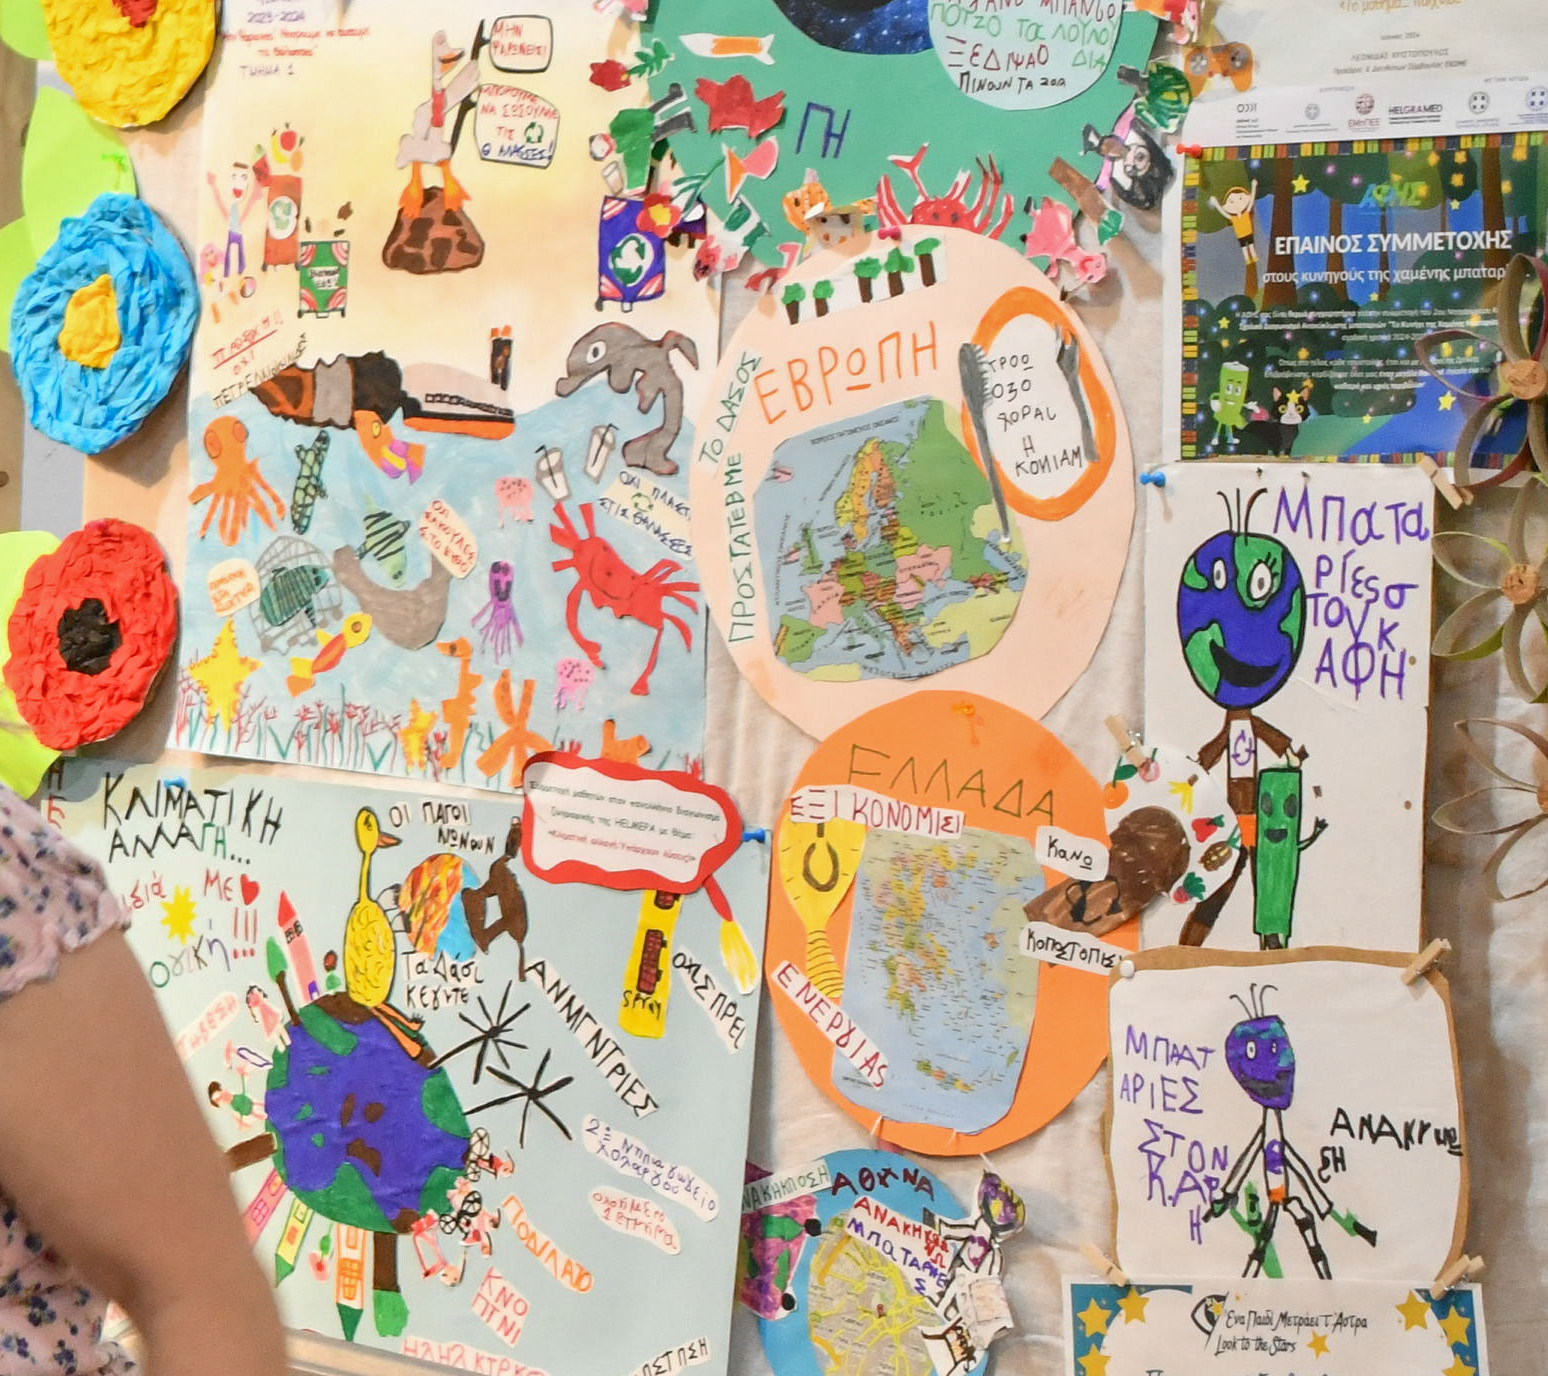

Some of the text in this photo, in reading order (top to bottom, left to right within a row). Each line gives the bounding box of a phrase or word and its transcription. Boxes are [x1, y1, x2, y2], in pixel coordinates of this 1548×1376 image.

[1275, 230, 1512, 256] ΕΠΑΙΝΟΣ ΣΥΜΜΕΤΟΧΗΣ
[1263, 265, 1451, 284] στους κυνηγούς της χαμένης
[103, 773, 283, 845] ΚΛΙΜΑΤΙΚΗ
[1215, 1334, 1296, 1356] Look to the Stars
